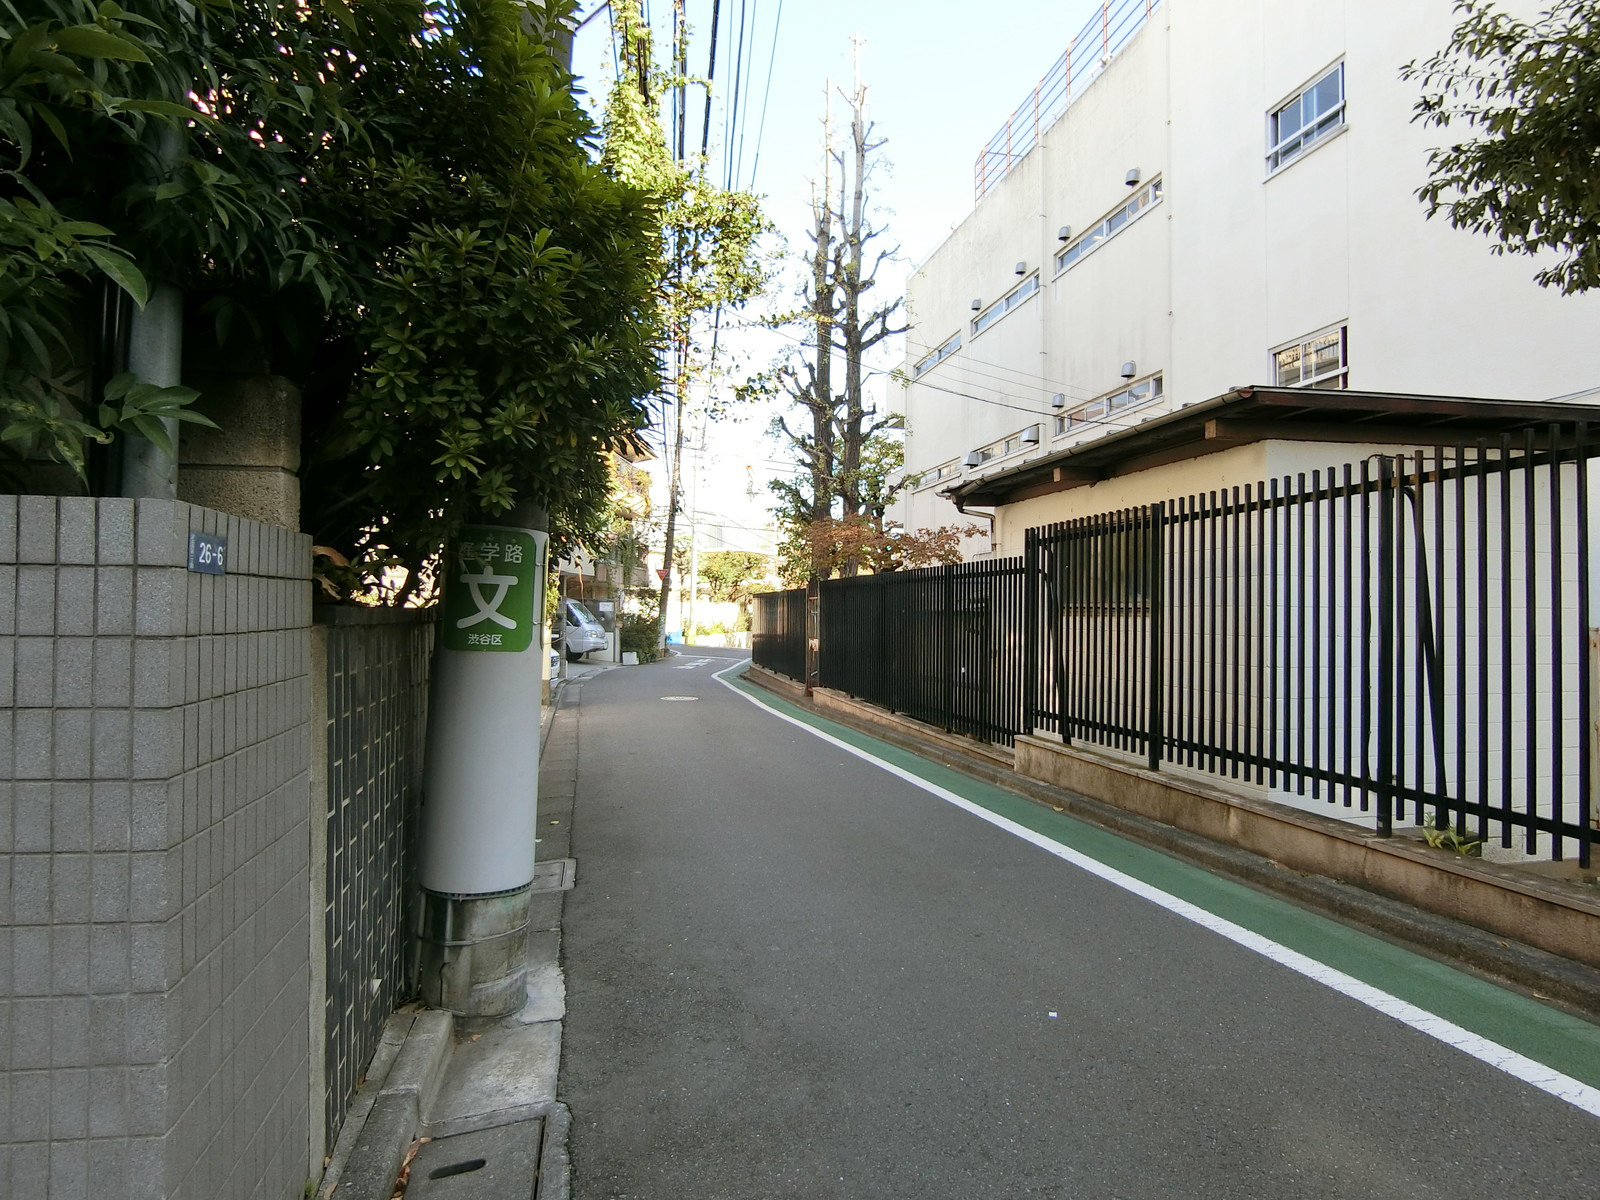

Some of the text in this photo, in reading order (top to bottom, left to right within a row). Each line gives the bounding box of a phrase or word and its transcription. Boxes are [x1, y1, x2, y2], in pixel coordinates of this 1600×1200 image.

[199, 542, 224, 566] 26-6
[456, 565, 519, 630] 文
[467, 633, 503, 645] 渋谷区
